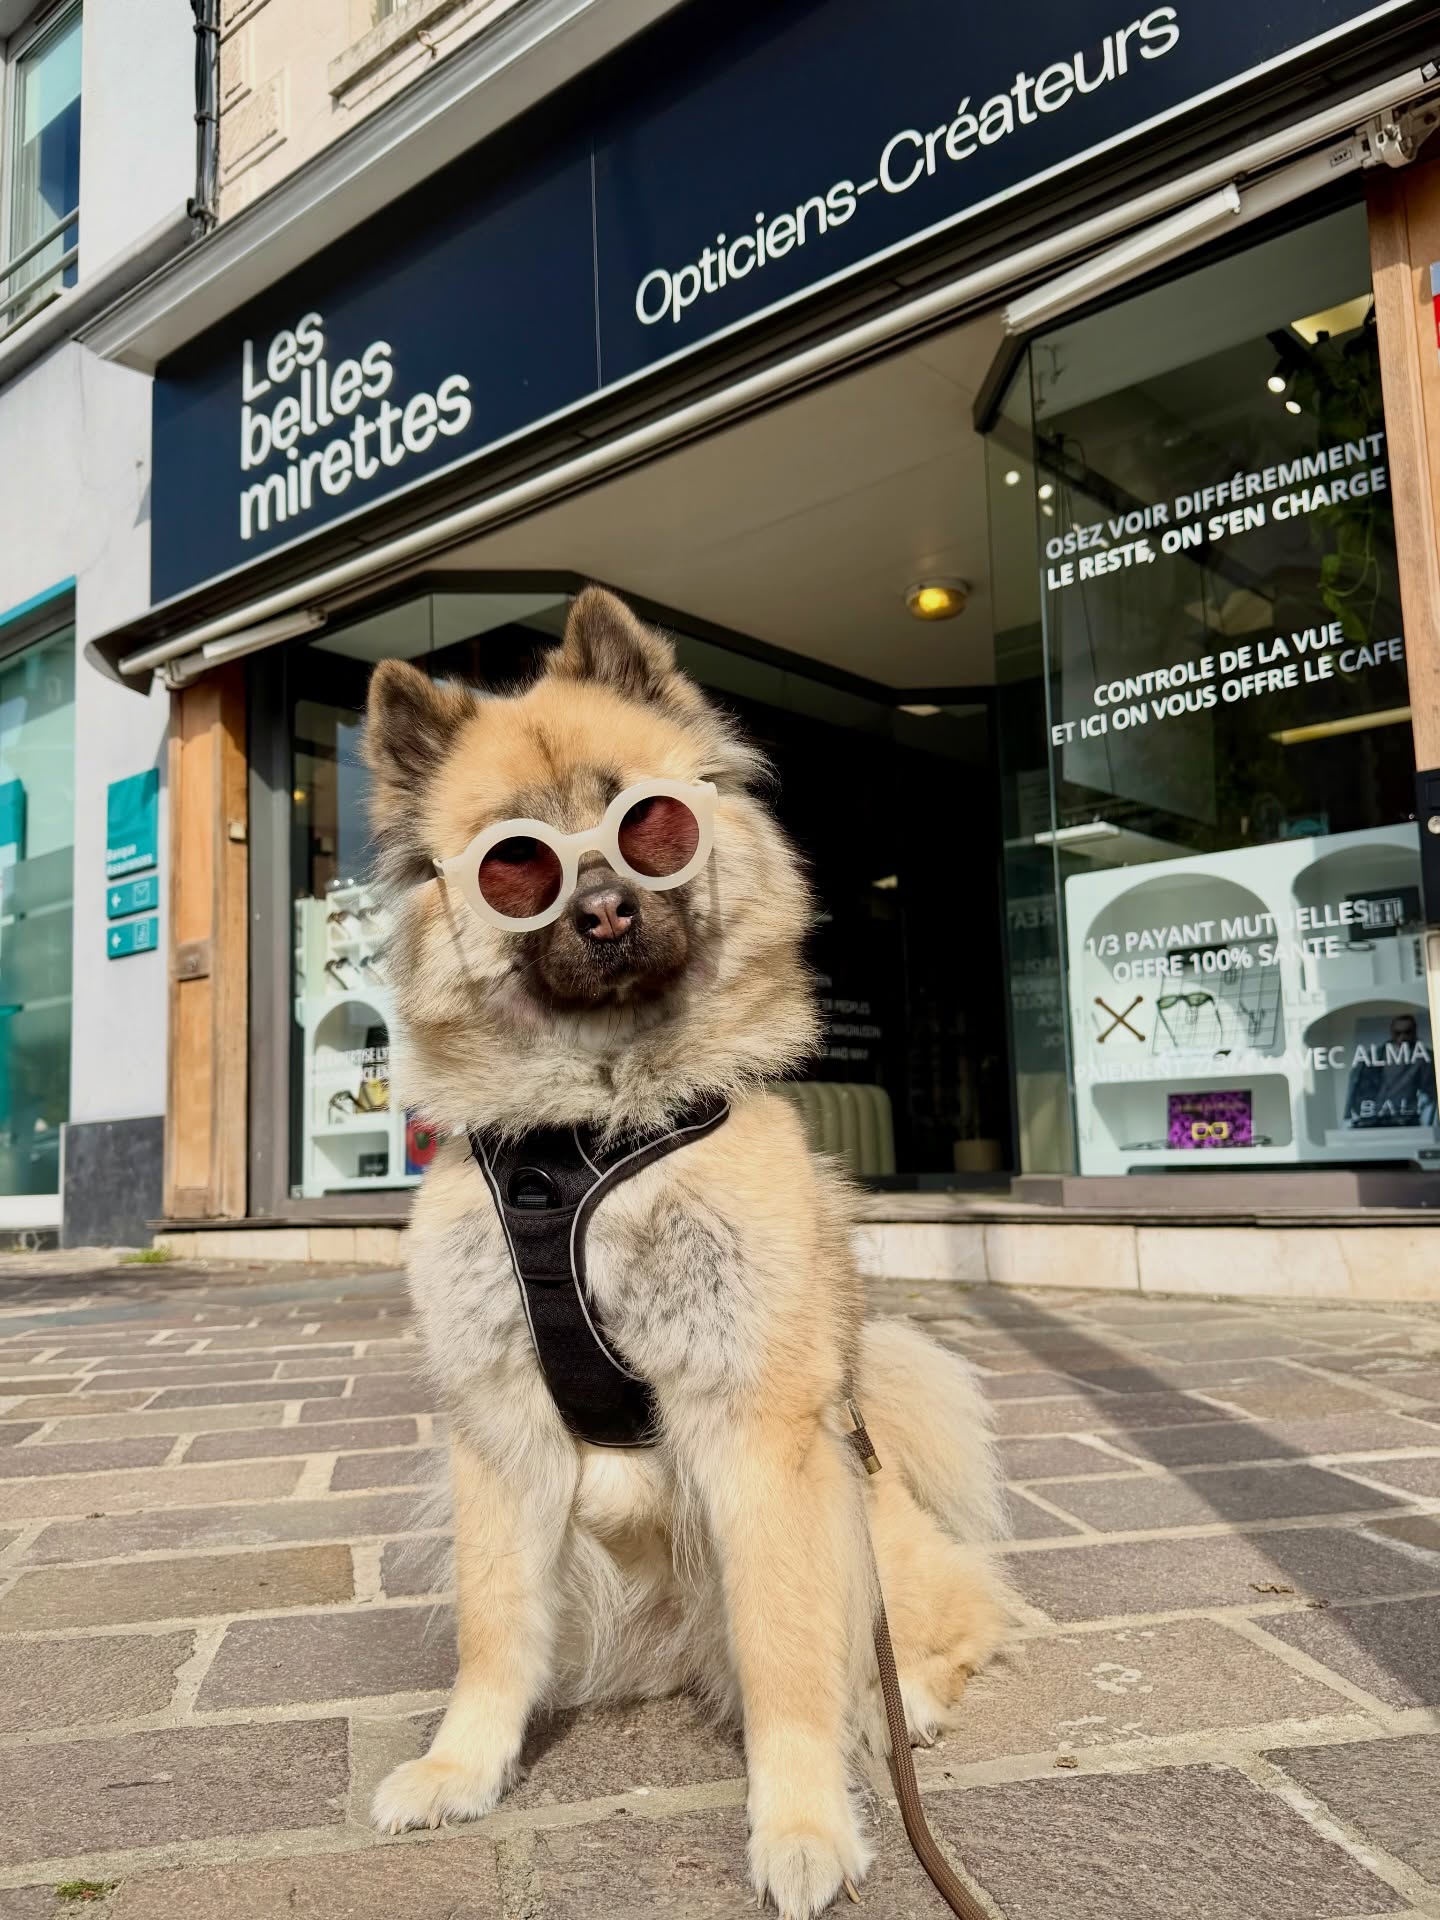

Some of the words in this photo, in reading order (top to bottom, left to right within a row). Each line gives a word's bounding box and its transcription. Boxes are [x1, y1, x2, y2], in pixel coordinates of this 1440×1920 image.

[635, 6, 1180, 325] Opticiens-Créateurs
[241, 341, 393, 471] belles
[243, 312, 324, 402] Les
[240, 374, 472, 540] mirettes
[1046, 523, 1105, 560] OSEZ
[1108, 504, 1169, 539] VOIR
[1175, 432, 1385, 519] DIFFÉREMMENT
[1047, 562, 1074, 591] LE
[1079, 538, 1156, 583] RESTE,
[1161, 525, 1203, 555] ON
[1208, 506, 1266, 542] S'EN
[1272, 466, 1387, 520] CHARGE
[1051, 720, 1077, 746] ET
[1081, 713, 1107, 739] ICI
[1111, 702, 1148, 731] ON
[1151, 685, 1217, 721] VOUS
[1221, 664, 1299, 703] OFFRE
[1304, 655, 1334, 683] LE
[1338, 638, 1404, 673] CAFE
[1094, 655, 1215, 707] CONTROLE
[1220, 644, 1251, 674] DE
[1257, 637, 1289, 664] LA
[1292, 621, 1344, 653] VUE
[1086, 932, 1119, 958] 1/3
[1125, 921, 1216, 953] PAYANT
[1113, 955, 1184, 983] OFFRE
[1190, 946, 1252, 974] 100%
[1258, 936, 1341, 967] SANTE
[1352, 1041, 1430, 1067] ALMA
